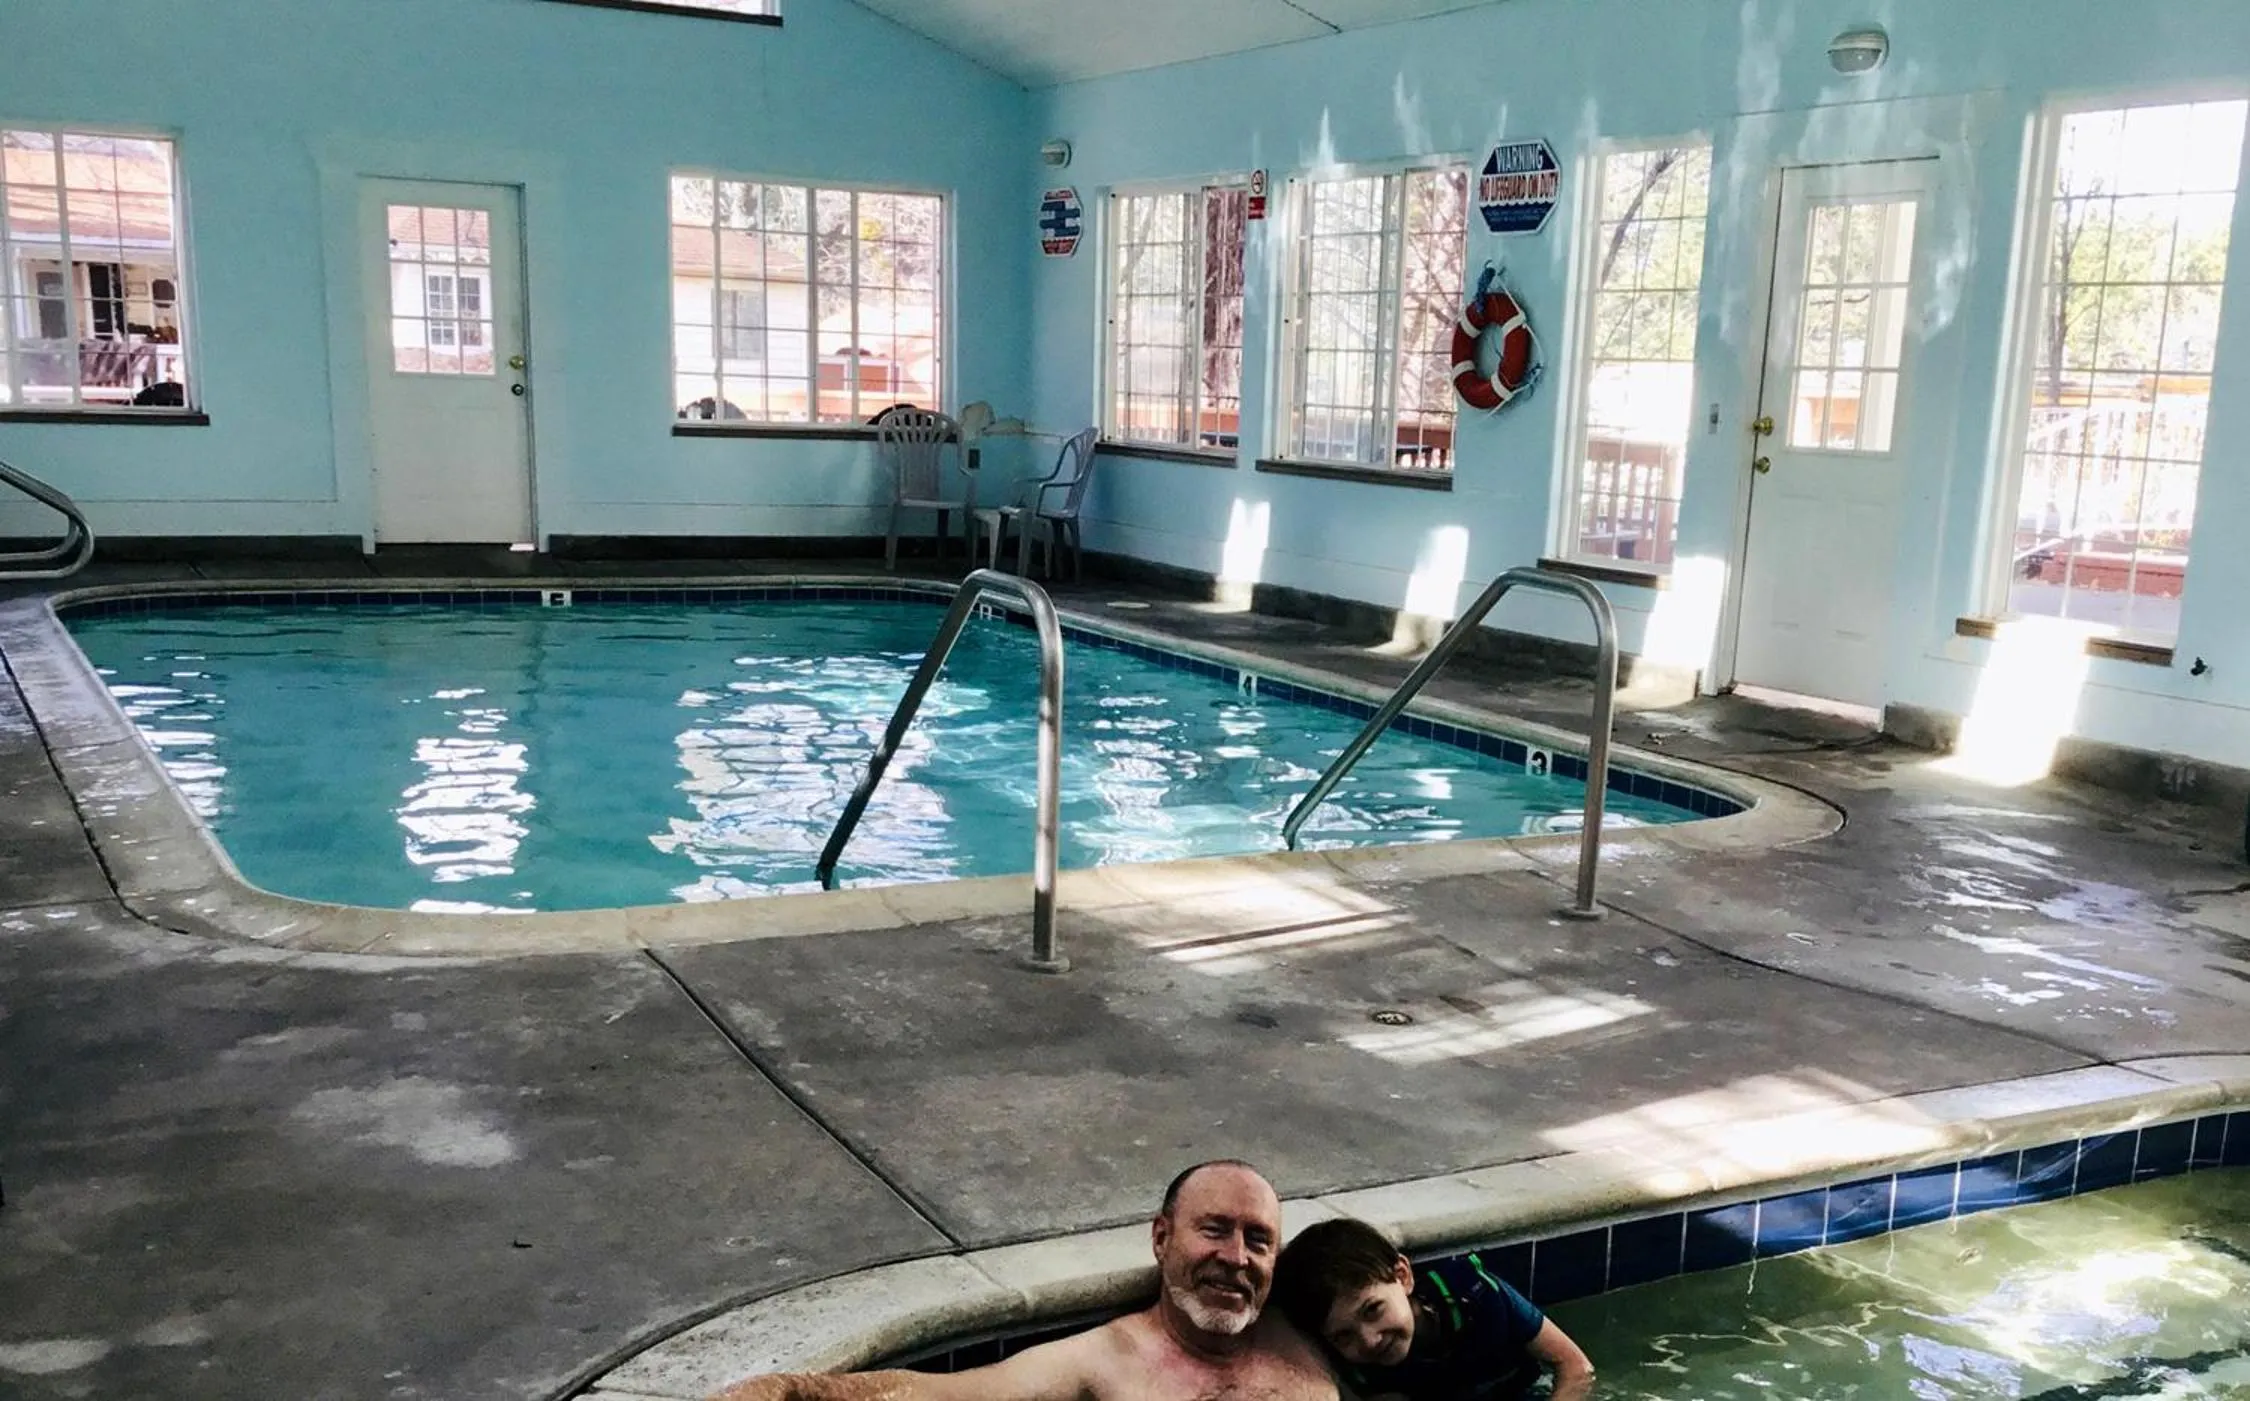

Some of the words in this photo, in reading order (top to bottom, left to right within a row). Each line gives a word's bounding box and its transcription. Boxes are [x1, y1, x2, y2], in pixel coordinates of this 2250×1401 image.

[1495, 144, 1544, 172] WARNING
[1479, 176, 1490, 202] NO
[1490, 174, 1526, 201] LIFEGUARD
[1528, 173, 1539, 199] ON
[1540, 171, 1558, 198] DUTY
